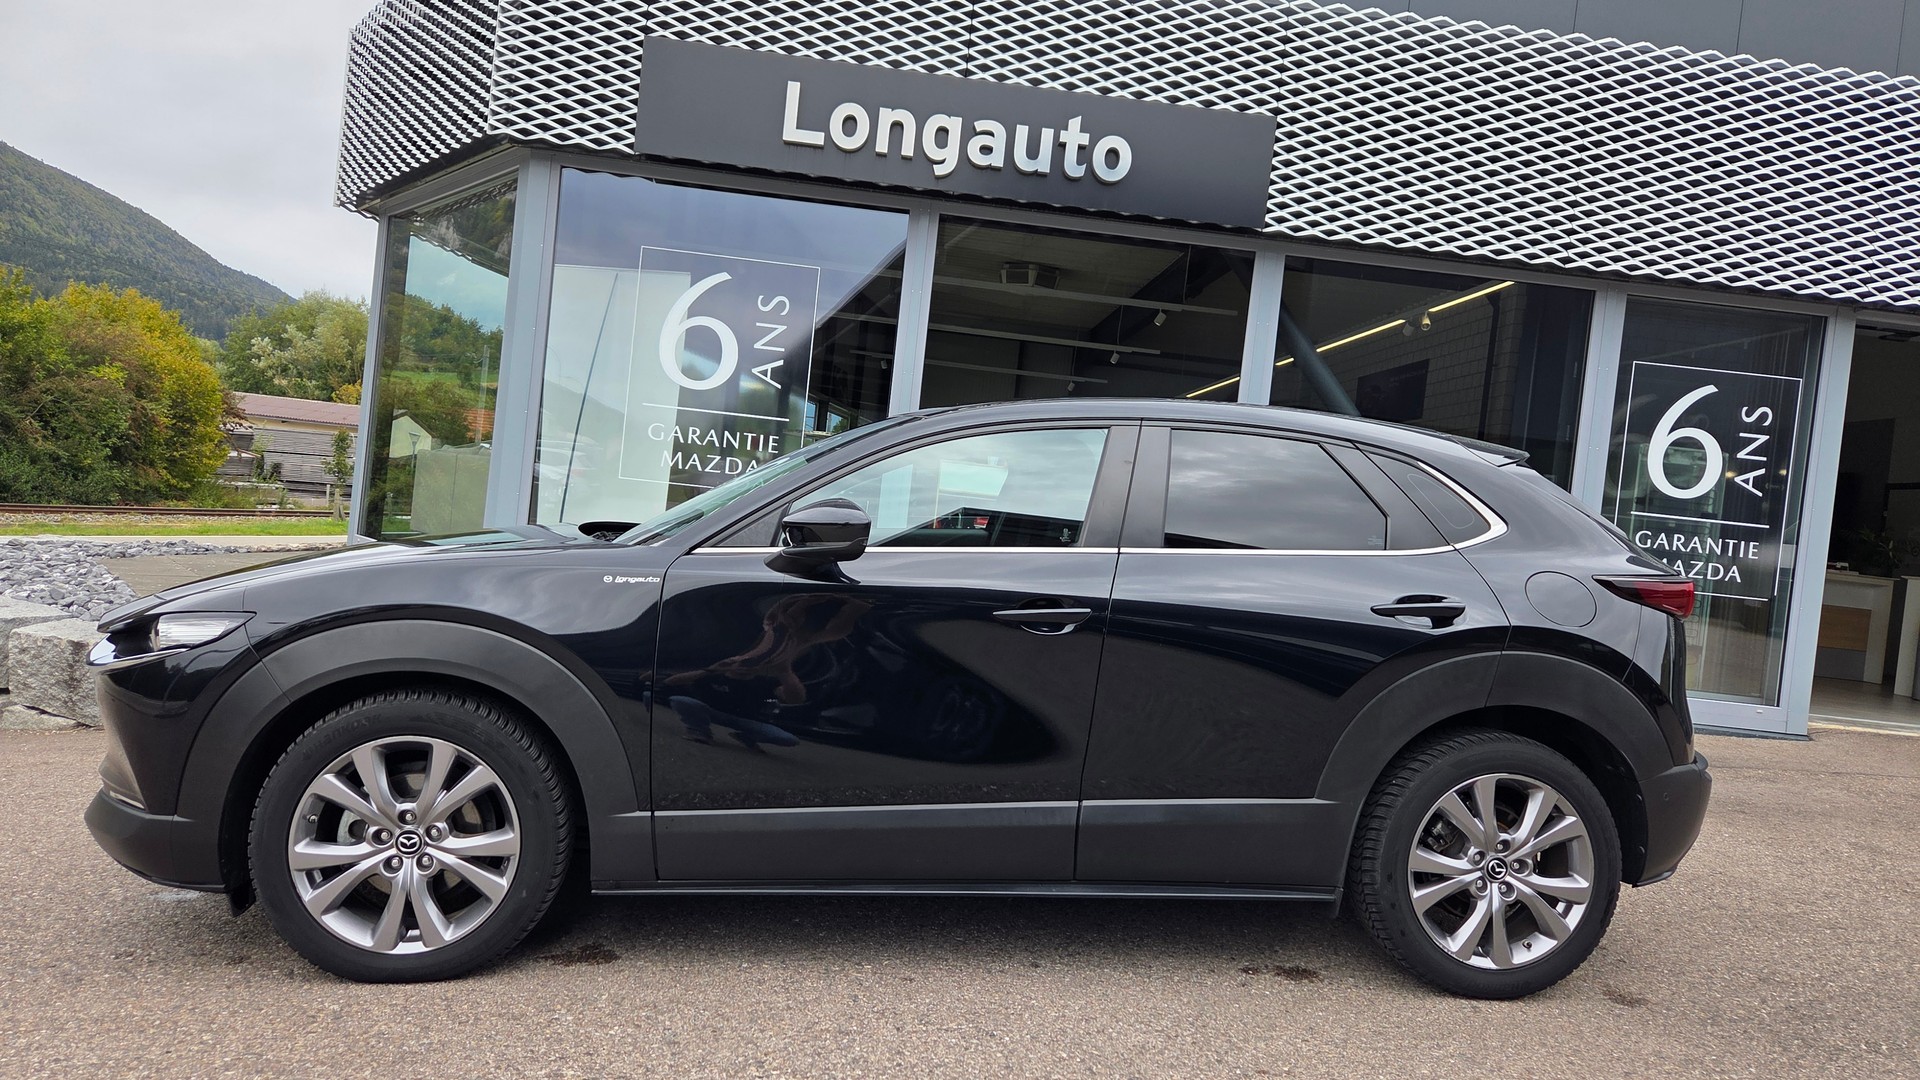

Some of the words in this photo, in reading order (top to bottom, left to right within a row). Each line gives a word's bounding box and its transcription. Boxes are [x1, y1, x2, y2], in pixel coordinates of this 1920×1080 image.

[781, 80, 1133, 184] Longauto
[659, 271, 739, 391] 6
[751, 295, 790, 389] ANS
[647, 422, 780, 454] GARANTIE
[1647, 384, 1723, 499] 6
[1734, 406, 1773, 497] ANS
[1635, 530, 1760, 560] GARANTIE
[1661, 558, 1742, 583] AZDA
